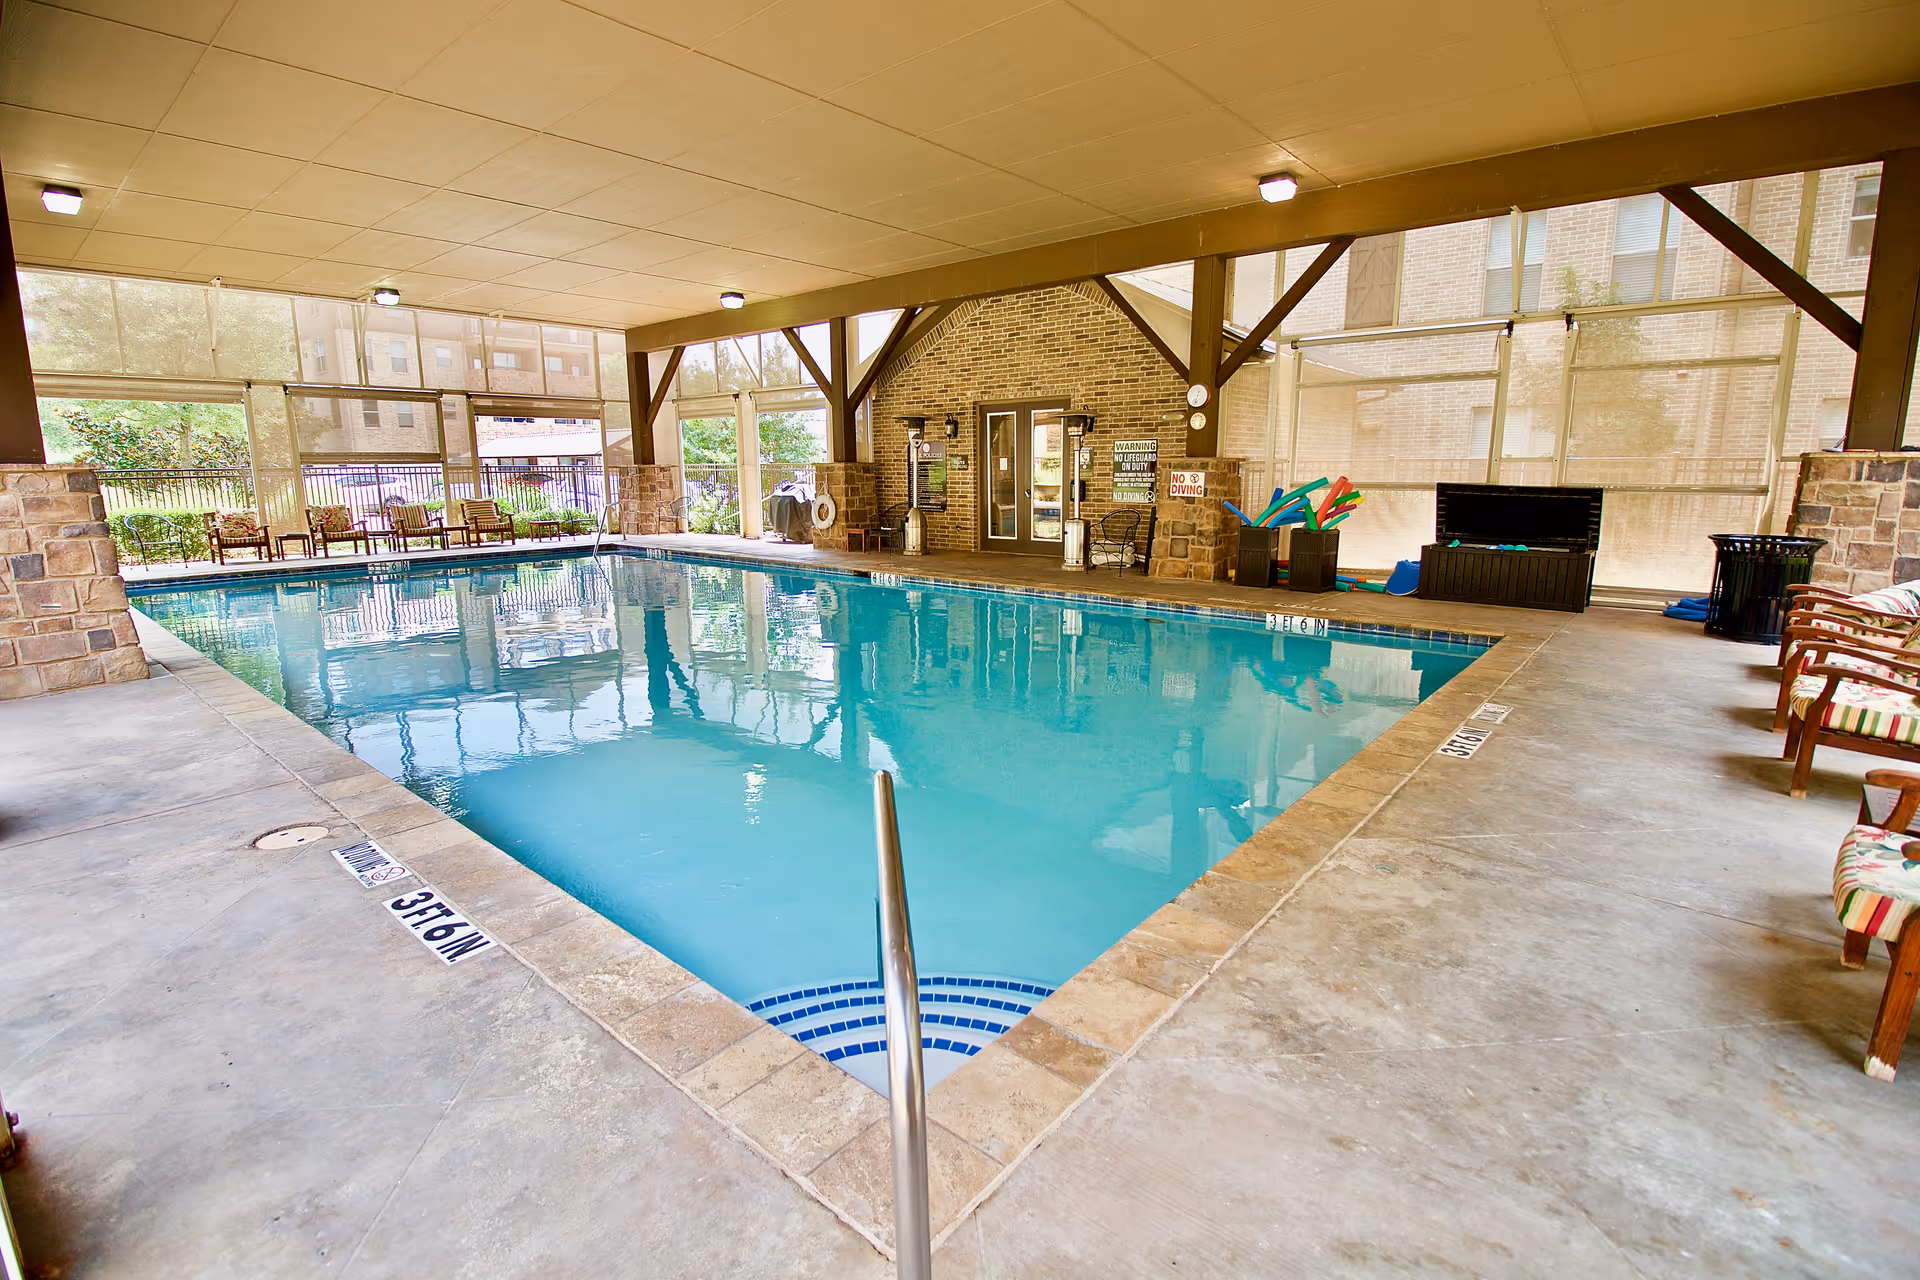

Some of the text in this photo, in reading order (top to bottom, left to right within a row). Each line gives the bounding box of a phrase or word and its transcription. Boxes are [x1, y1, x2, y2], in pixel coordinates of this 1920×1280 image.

[1116, 442, 1156, 450] WARNING
[1114, 453, 1156, 462] NO LIFEGUARD
[1122, 462, 1148, 470] ON DUTY
[1172, 474, 1185, 484] NO
[1172, 484, 1202, 495] DIVING
[1113, 492, 1144, 500] NO DIVING
[1270, 614, 1325, 628] 3 FT 6 IN
[1441, 748, 1470, 756] 3
[337, 842, 390, 873] NO DIVING
[391, 892, 434, 910] 3
[423, 922, 470, 941] 6
